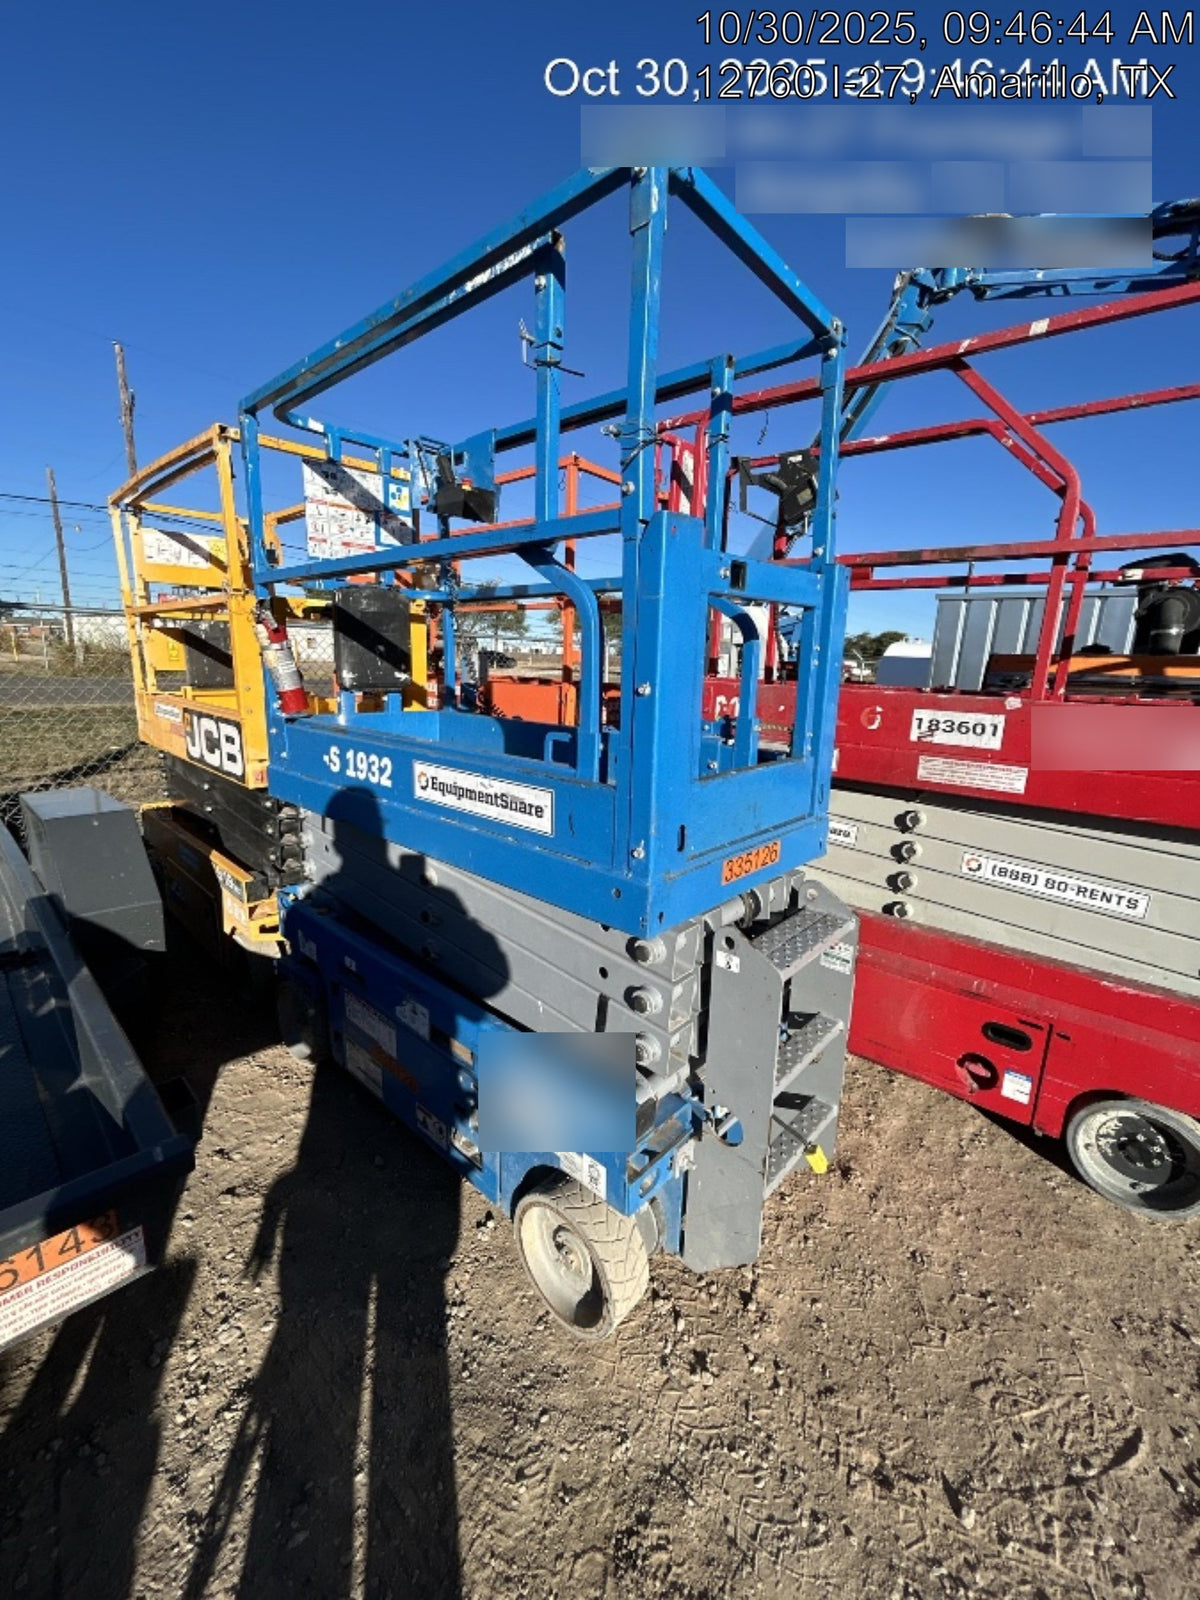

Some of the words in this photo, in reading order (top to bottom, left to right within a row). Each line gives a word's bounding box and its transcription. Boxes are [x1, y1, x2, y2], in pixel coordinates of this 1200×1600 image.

[186, 714, 244, 776] JCB
[915, 717, 999, 737] 183601
[346, 748, 392, 788] 1932
[430, 776, 545, 818] EquipmentShare
[725, 842, 778, 882] 335126
[991, 864, 1039, 886] (888)
[1044, 878, 1140, 909] 80-RENTS
